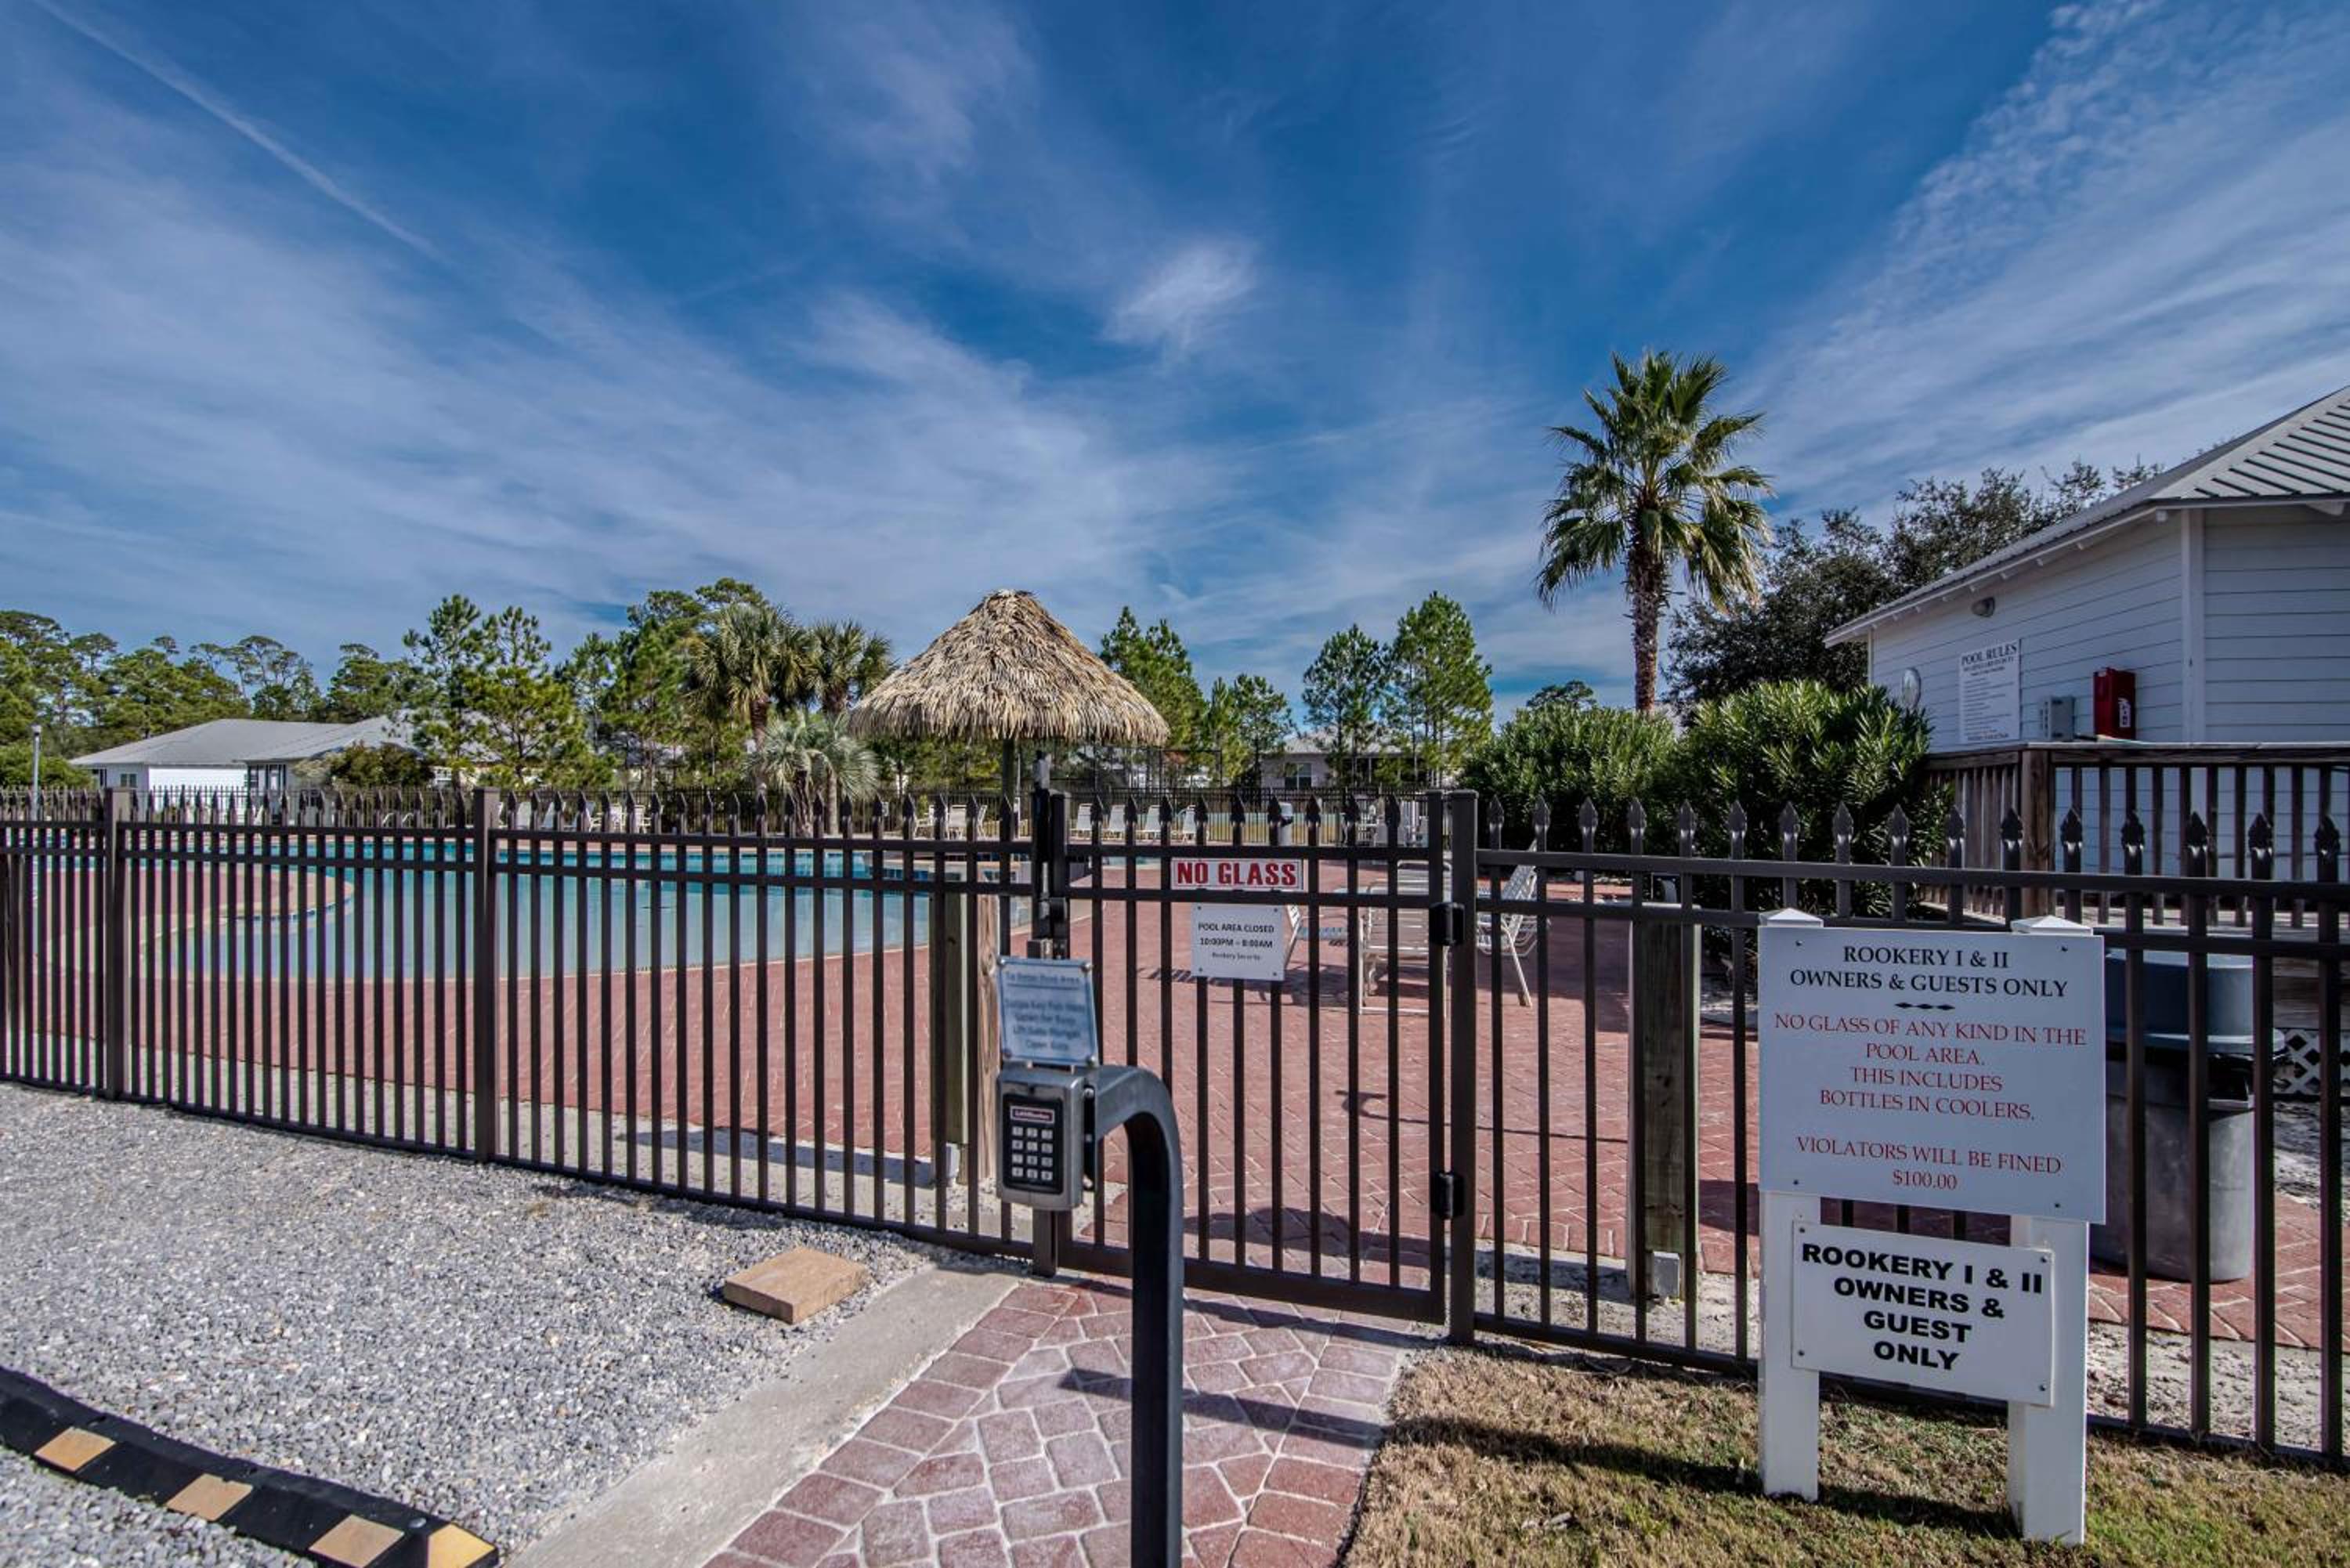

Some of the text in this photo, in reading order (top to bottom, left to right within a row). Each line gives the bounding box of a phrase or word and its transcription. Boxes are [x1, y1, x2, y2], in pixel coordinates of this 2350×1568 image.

[1961, 652, 1982, 666] POOL
[1987, 645, 2016, 659] RULES
[1177, 863, 1296, 885] NO GLASS
[1200, 938, 1233, 946] 10:00PM
[1843, 945, 2008, 968] ROOKERY I & II
[1790, 970, 2068, 997] OWNERS & GUESTS ONLY
[1775, 1013, 2087, 1046] NO GLASS OF ANY KIND IN THE
[1867, 1043, 1985, 1065] POOL AREA.
[1850, 1067, 2002, 1091] THIS INCLUDES
[1820, 1089, 2035, 1120] BOTTLES IN COOLERS.
[1797, 1136, 2062, 1174] VIOLATORS WILL BE FINED
[1893, 1170, 1957, 1190] $100.00
[1802, 1244, 2042, 1294] ROOKERY I & II
[1835, 1277, 2005, 1318] OWNERS &
[1864, 1311, 1972, 1342] GUEST
[1874, 1341, 1959, 1371] ONLY
